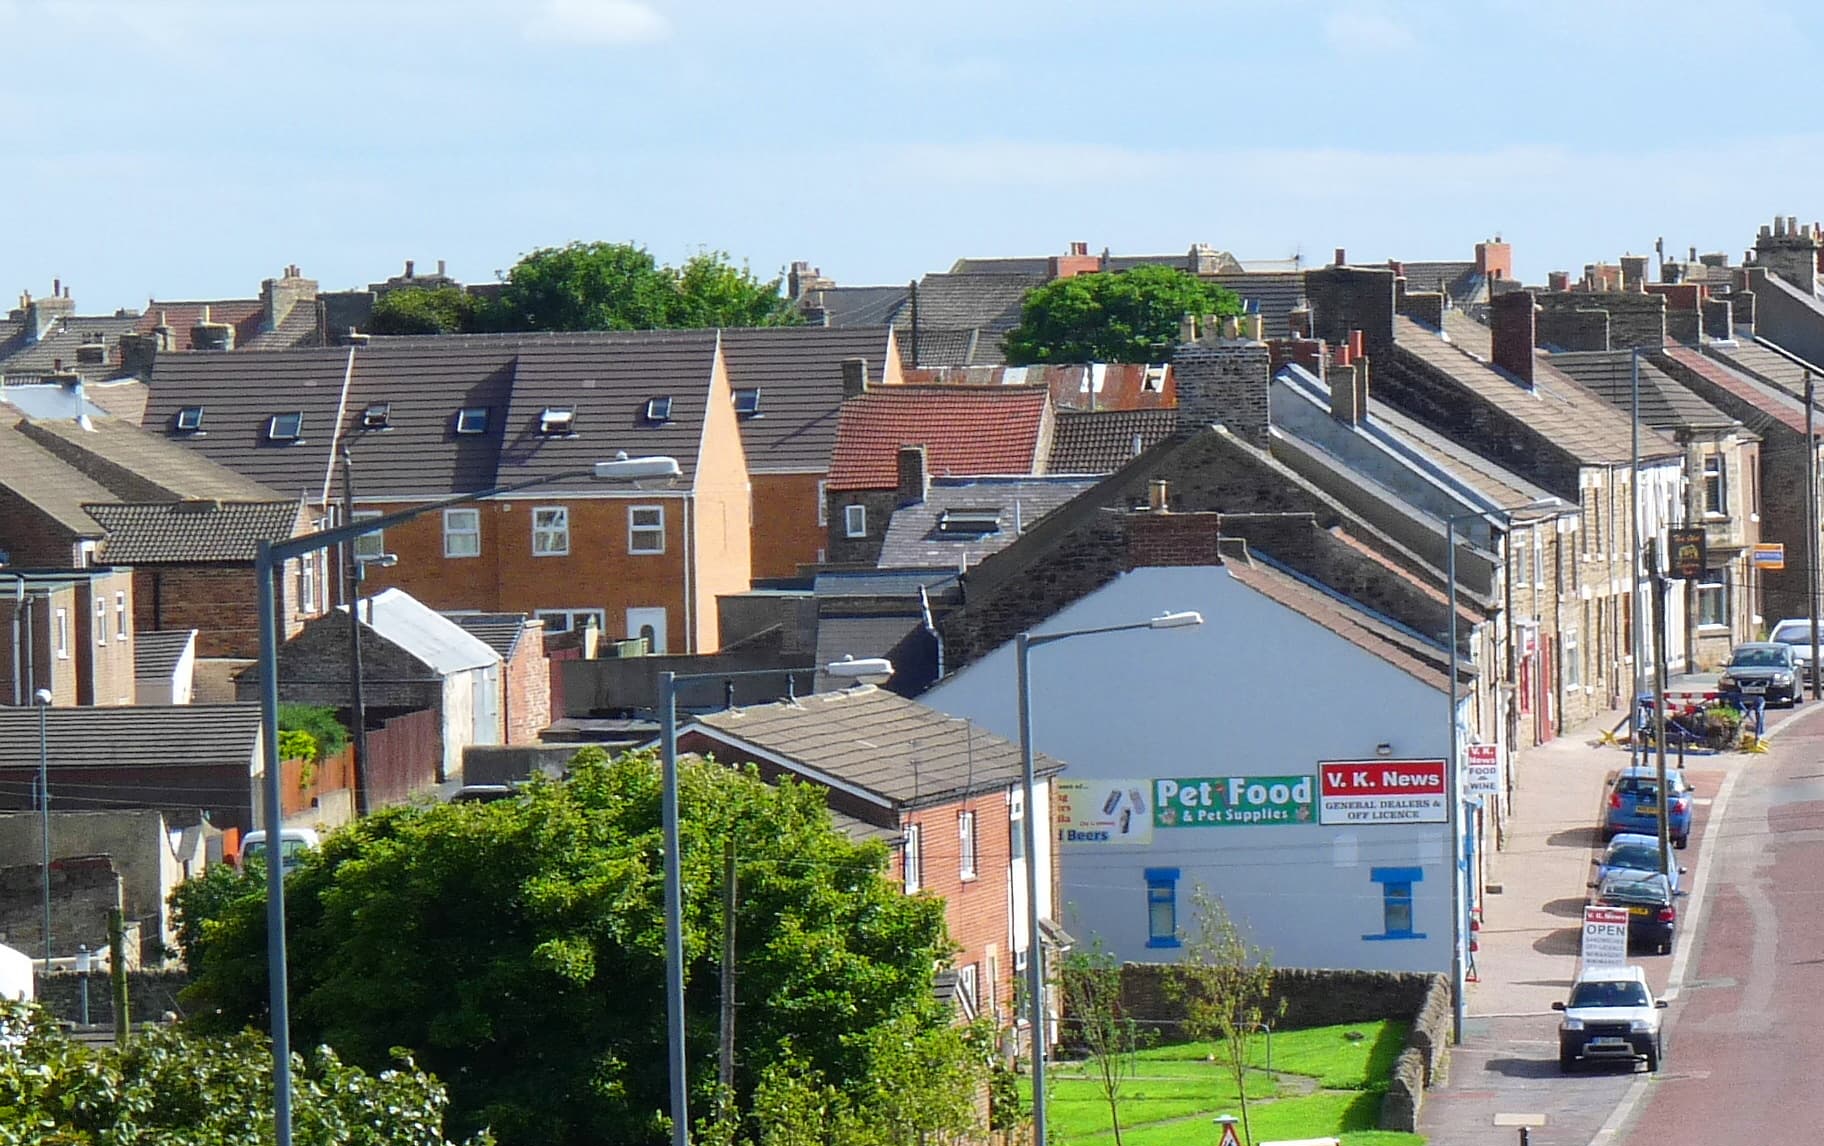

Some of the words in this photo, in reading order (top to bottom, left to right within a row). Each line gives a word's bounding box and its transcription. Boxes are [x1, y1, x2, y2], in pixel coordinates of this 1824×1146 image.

[1469, 767, 1496, 775] FOOD
[1327, 772, 1346, 788] V.
[1352, 771, 1375, 787] K.
[1382, 771, 1440, 787] News
[1157, 779, 1212, 807] Pet
[1228, 776, 1312, 805] Food
[1470, 782, 1497, 790] WINE
[1325, 800, 1376, 810] GENERAL
[1380, 799, 1430, 809] DEALERS
[1432, 799, 1440, 808] &
[1182, 810, 1194, 823] &
[1198, 809, 1221, 822] Pet
[1225, 807, 1288, 823] Supplies
[1347, 811, 1369, 820] OFF
[1372, 810, 1420, 820] LICENCE
[1067, 829, 1111, 842] Beers
[1586, 924, 1626, 936] OPEN
